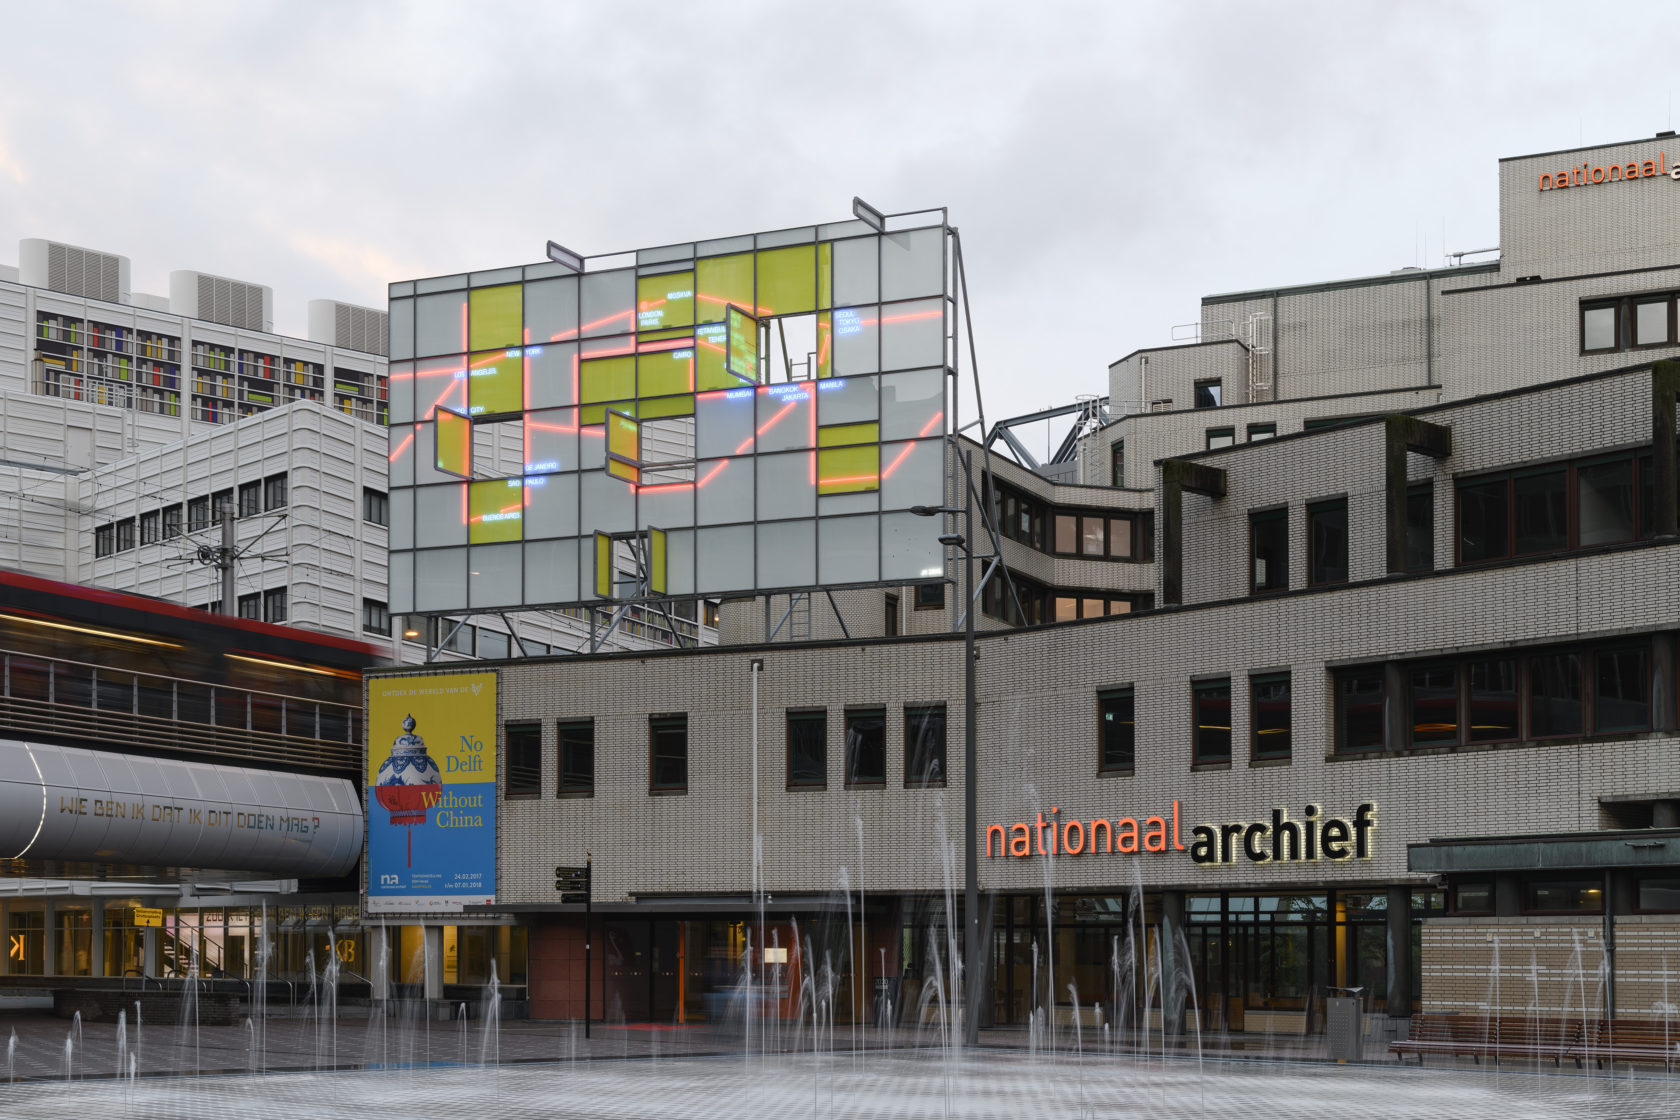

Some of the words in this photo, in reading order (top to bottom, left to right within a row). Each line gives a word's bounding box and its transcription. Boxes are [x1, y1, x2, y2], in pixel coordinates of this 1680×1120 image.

[1539, 152, 1667, 191] nationaal
[638, 310, 664, 319] LONDON
[673, 351, 692, 359] CAIRO
[471, 368, 497, 376] ANGELES
[769, 386, 798, 395] BANGKOK
[819, 382, 843, 390] MANILA
[726, 390, 752, 399] MUMBAI
[782, 393, 809, 402] JAKARTA
[534, 462, 557, 470] JANEIRO
[460, 735, 483, 752] No
[445, 754, 484, 773] Delft
[421, 791, 484, 809] Without
[60, 796, 88, 816] WIE
[94, 799, 126, 819] BEN
[131, 802, 145, 820] IK
[152, 804, 184, 823] DAT
[189, 807, 202, 824] IK
[208, 810, 231, 827] DIT
[237, 812, 274, 831] DOEN
[436, 810, 483, 828] China
[986, 800, 1184, 858] nationaal
[1190, 804, 1374, 864] archief
[381, 874, 399, 885] na
